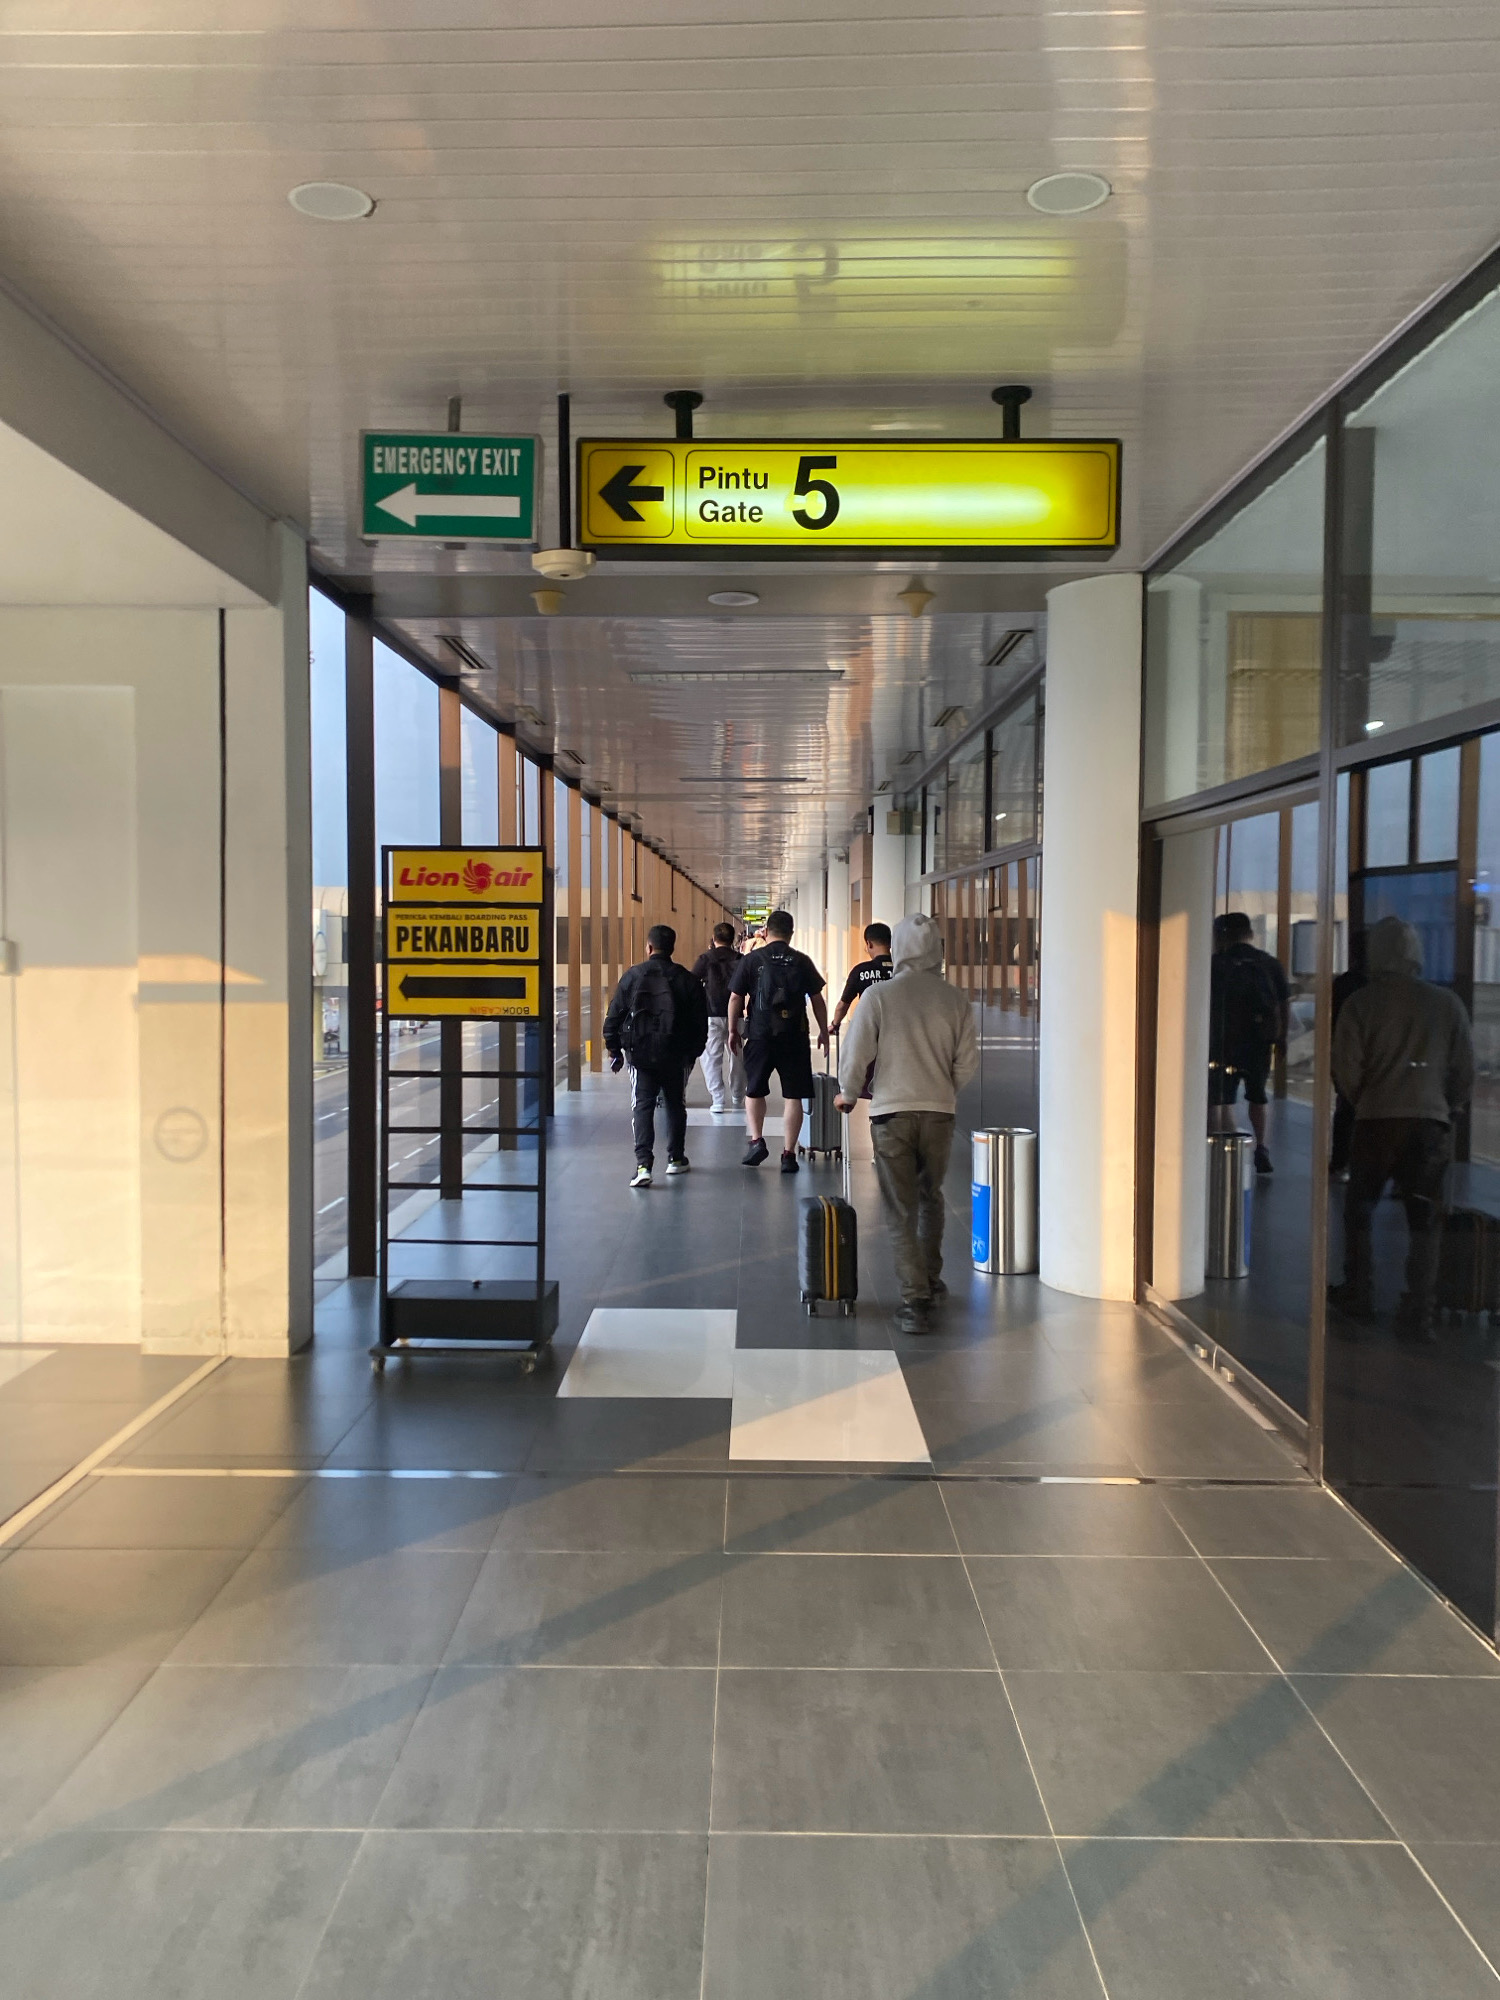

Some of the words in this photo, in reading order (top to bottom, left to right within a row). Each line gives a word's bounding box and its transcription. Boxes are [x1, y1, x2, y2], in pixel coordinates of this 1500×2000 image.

[373, 446, 478, 475] EMERGENCY
[481, 448, 521, 476] EXIT
[699, 466, 769, 490] Pintu
[792, 455, 840, 530] 5
[699, 499, 763, 523] Gate
[399, 867, 459, 886] Lion
[494, 866, 533, 886] air
[396, 925, 529, 953] PEKANBARU
[859, 970, 881, 981] SOAR
